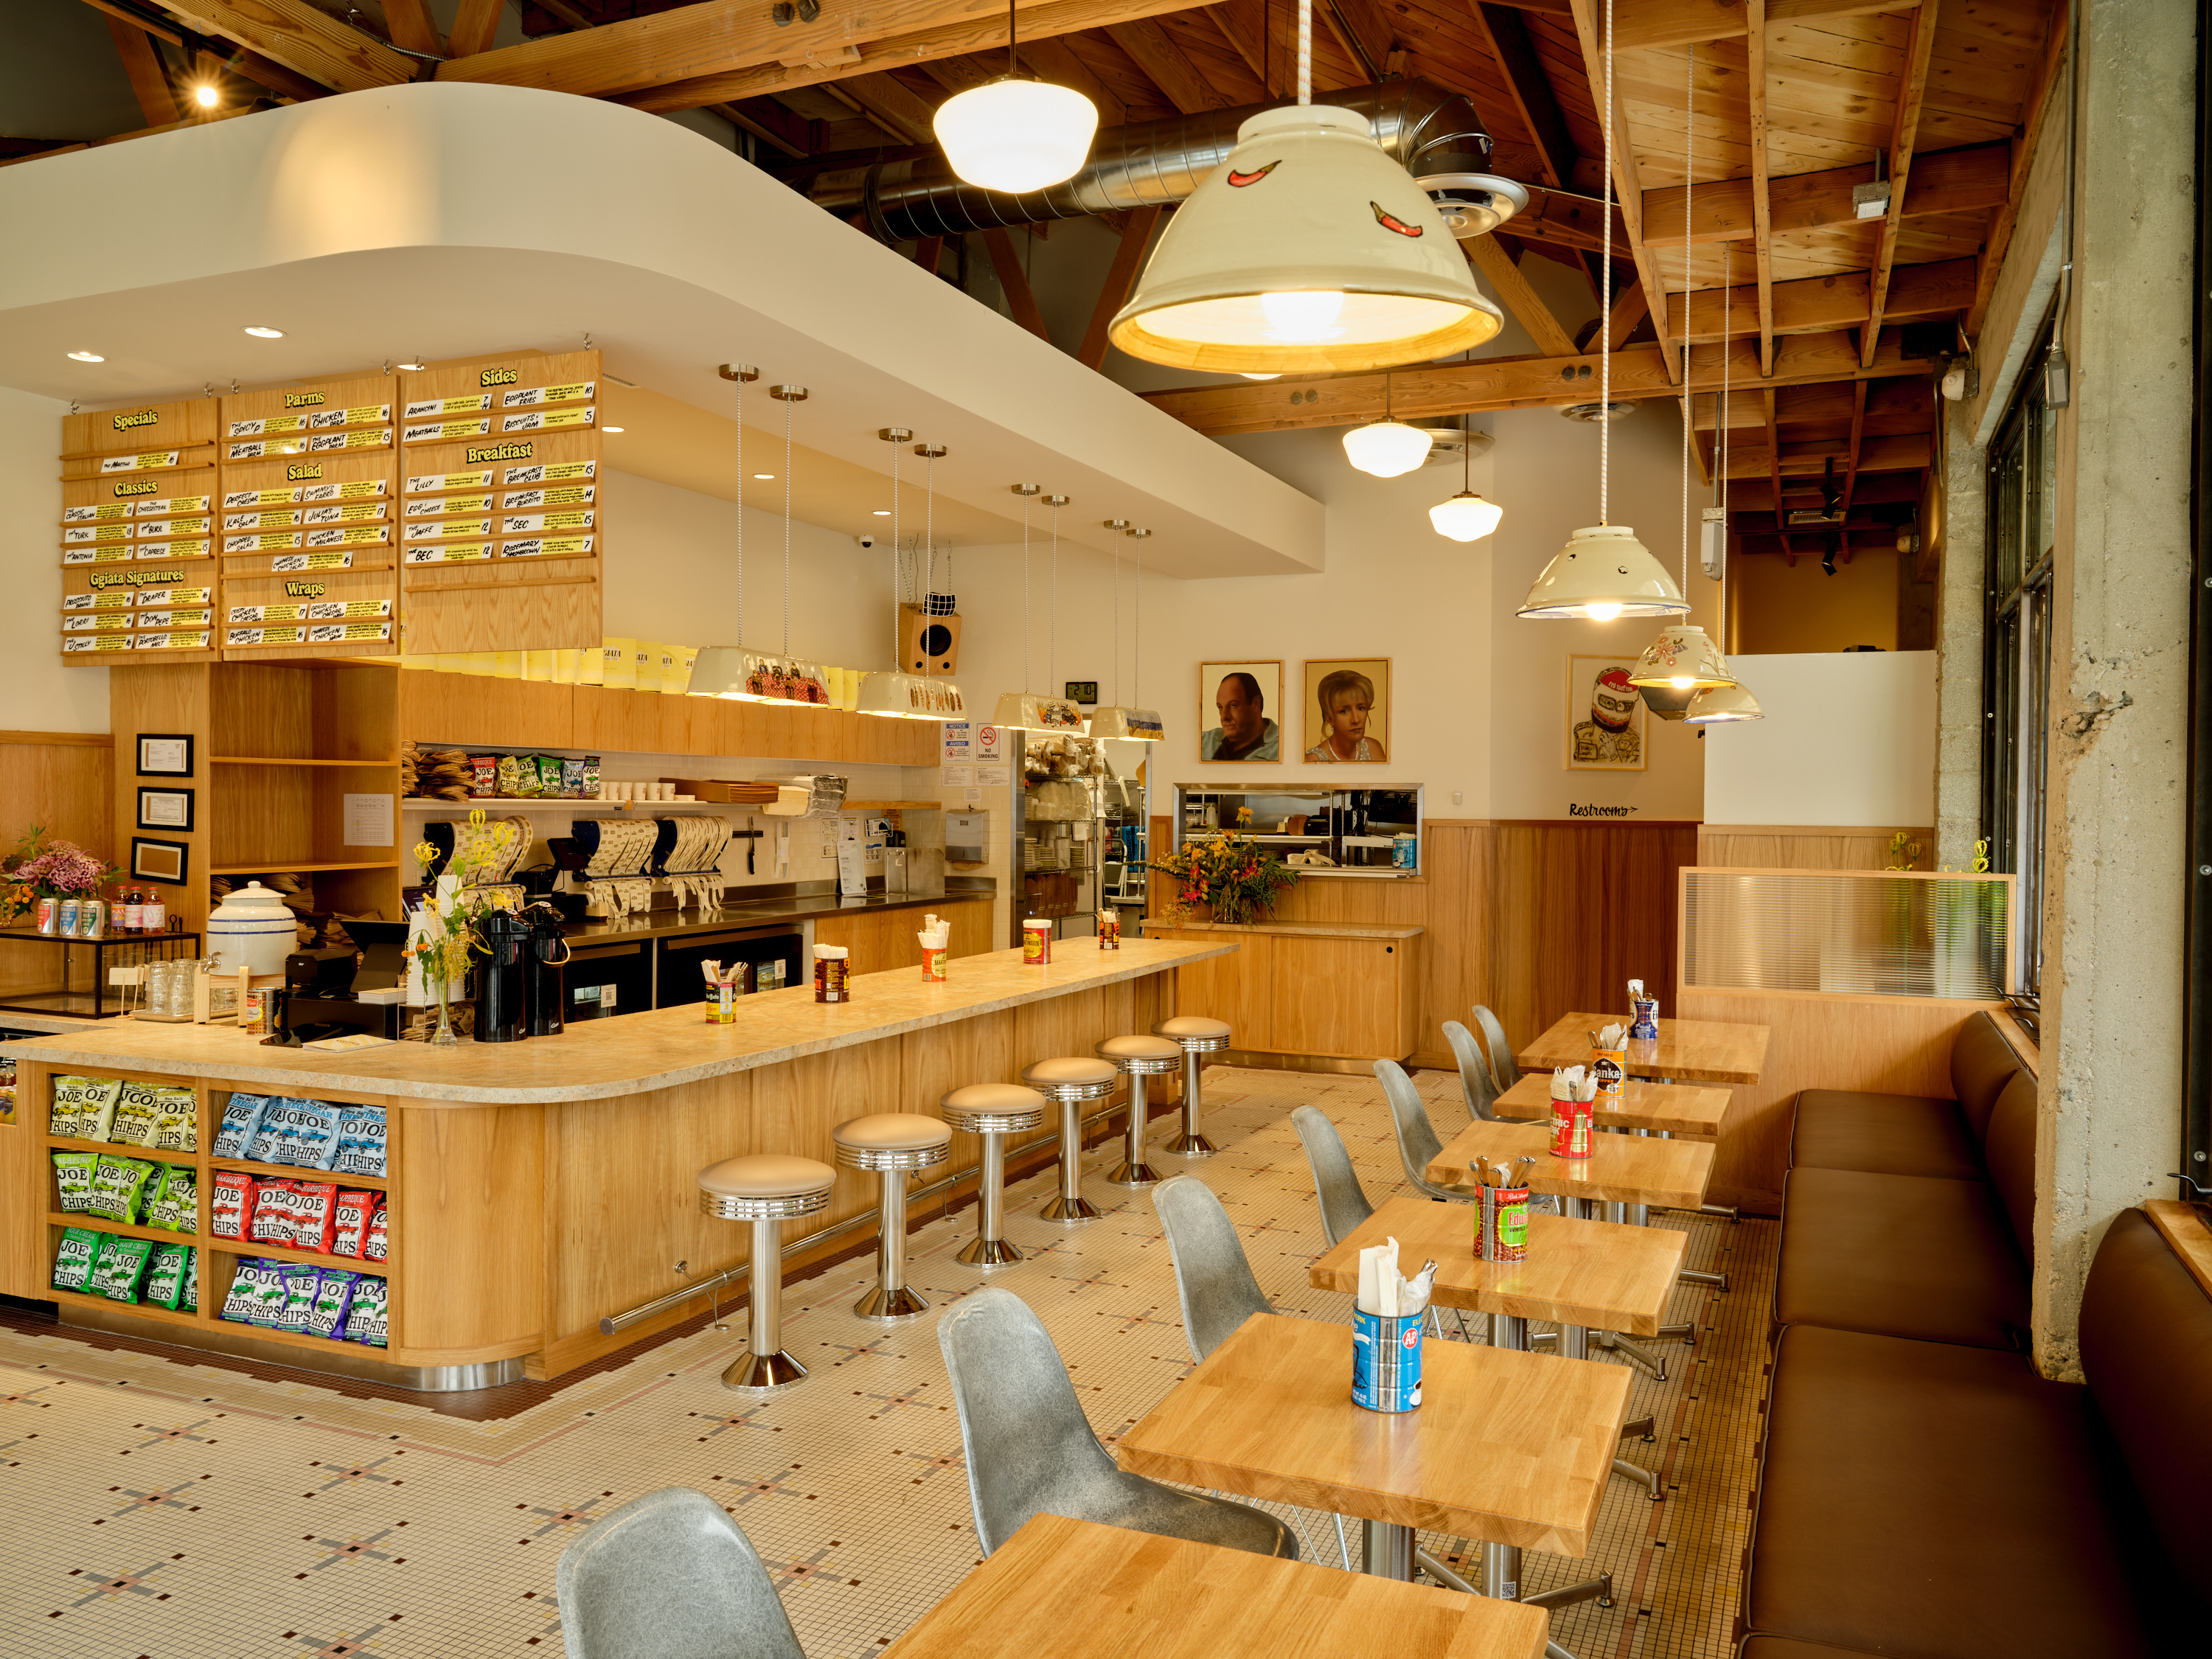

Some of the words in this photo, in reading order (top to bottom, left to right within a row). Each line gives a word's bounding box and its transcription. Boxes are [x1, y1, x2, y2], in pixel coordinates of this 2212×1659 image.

[481, 368, 518, 387] Sides
[504, 389, 538, 404] EGGPLANT
[585, 386, 592, 394] 10
[285, 392, 325, 408] Parms
[519, 397, 537, 406] FRIES
[407, 404, 437, 417] ARANCINI
[585, 411, 592, 421] 5
[114, 410, 158, 431] Specials
[313, 410, 344, 428] CHICKEN
[504, 414, 536, 431] BISCUITS
[522, 420, 539, 430] JAM
[406, 425, 441, 440] MEATBALLS
[479, 422, 488, 431] 12
[311, 434, 346, 451] EGGPLANT
[230, 444, 261, 459] MEATBALL
[467, 442, 533, 464] Breakfast
[288, 463, 323, 481] Salad
[507, 466, 543, 484] BREAKFAST
[585, 465, 594, 474] 15
[524, 473, 541, 482] CLUB
[114, 479, 158, 497] Classics
[414, 479, 434, 491] LILLY
[504, 491, 539, 507] BREAKFAST
[516, 496, 540, 507] BURRITO
[138, 504, 167, 513] CHEESESTEAK
[407, 503, 423, 514] EGG
[420, 504, 441, 515] CHEESE
[77, 512, 96, 521] ITALIAN
[226, 515, 245, 528] KALE
[321, 512, 340, 522] TUNA
[149, 526, 162, 534] BURR
[481, 522, 488, 531] 12
[512, 520, 529, 529] SEC
[308, 529, 335, 544] CHICKEN
[316, 535, 344, 546] MILANESE
[145, 547, 166, 556] CAPRESE
[236, 541, 254, 552] SALAD
[482, 546, 490, 554] 12
[503, 539, 540, 554] ROSEMARY
[416, 550, 434, 561] BEC
[90, 571, 125, 590] Ggiata
[127, 569, 184, 588] Signatures
[286, 581, 325, 599] Wraps
[142, 591, 166, 604] DRAPER
[232, 607, 257, 622] CHICKEN
[312, 603, 338, 618] CHICKEN
[145, 614, 158, 625] DON
[155, 618, 170, 626] PEPE
[234, 631, 261, 644] CHICKEN
[314, 627, 341, 641] CHICKEN
[150, 640, 165, 648] MELT
[543, 785, 560, 793] CHIPS
[584, 783, 599, 791] CHIPS
[1570, 804, 1627, 816] Restrooms
[58, 1091, 83, 1103] JOE
[224, 1107, 251, 1121] JOE
[215, 1137, 239, 1152] HIPS
[296, 1147, 321, 1161] HIPS
[358, 1155, 382, 1170] HIPS
[58, 1169, 87, 1180] JOE
[97, 1165, 119, 1180] JOE
[216, 1174, 247, 1184] BARBEQUE
[214, 1188, 239, 1202] JOE
[302, 1184, 332, 1193] BARBEQUE
[61, 1197, 91, 1208] CHIPS
[90, 1196, 114, 1211] CHIPS
[296, 1197, 323, 1211] JOE
[152, 1205, 178, 1221] CHIPS
[68, 1227, 79, 1235] SOUR
[80, 1230, 96, 1239] CREAM
[62, 1241, 88, 1256] JOE
[116, 1255, 139, 1268] JOE
[54, 1270, 84, 1286] CHIPS
[282, 1267, 320, 1276] PICKLE
[323, 1271, 357, 1281] PICKLE
